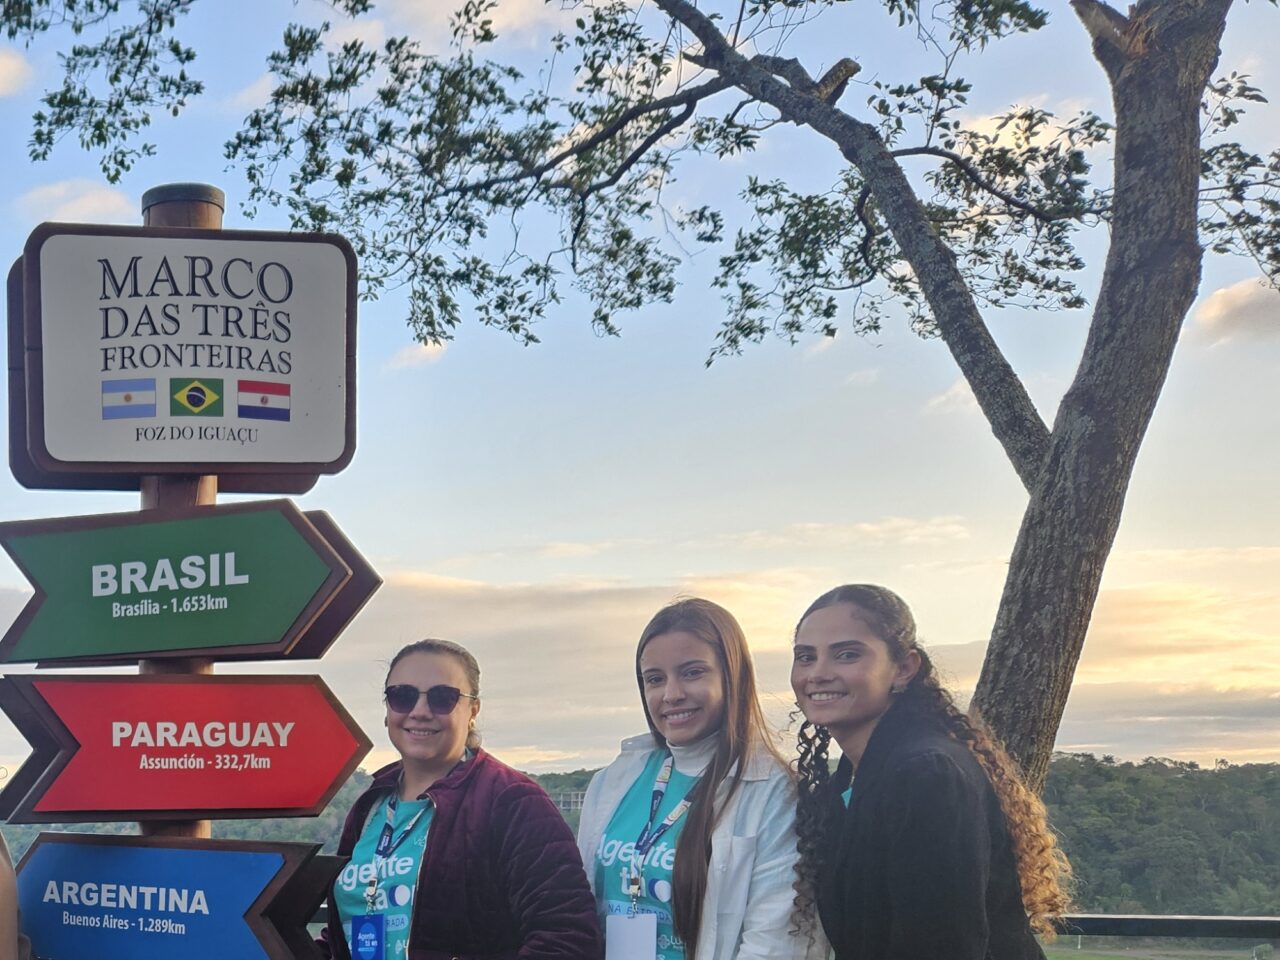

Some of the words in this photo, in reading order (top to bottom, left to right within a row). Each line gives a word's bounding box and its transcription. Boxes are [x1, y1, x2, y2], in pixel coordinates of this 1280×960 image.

[97, 255, 294, 304] MARCO
[99, 304, 181, 340] DAS
[192, 301, 292, 343] TRÊS
[100, 343, 293, 375] FRONTEIRAS
[135, 426, 167, 442] FOZ
[170, 426, 194, 441] DO
[198, 427, 259, 446] IGUAÇU
[91, 552, 249, 597] BRASIL
[112, 599, 160, 618] Brasília
[171, 594, 228, 614] 1.653km
[112, 722, 295, 748] PARAGUAY
[140, 753, 205, 770] Assunción
[215, 753, 271, 771] 332,7km
[43, 880, 210, 915] ARGENTINA
[62, 911, 101, 929] Buenos
[103, 914, 130, 931] Aires
[138, 916, 186, 935] 1.289km
